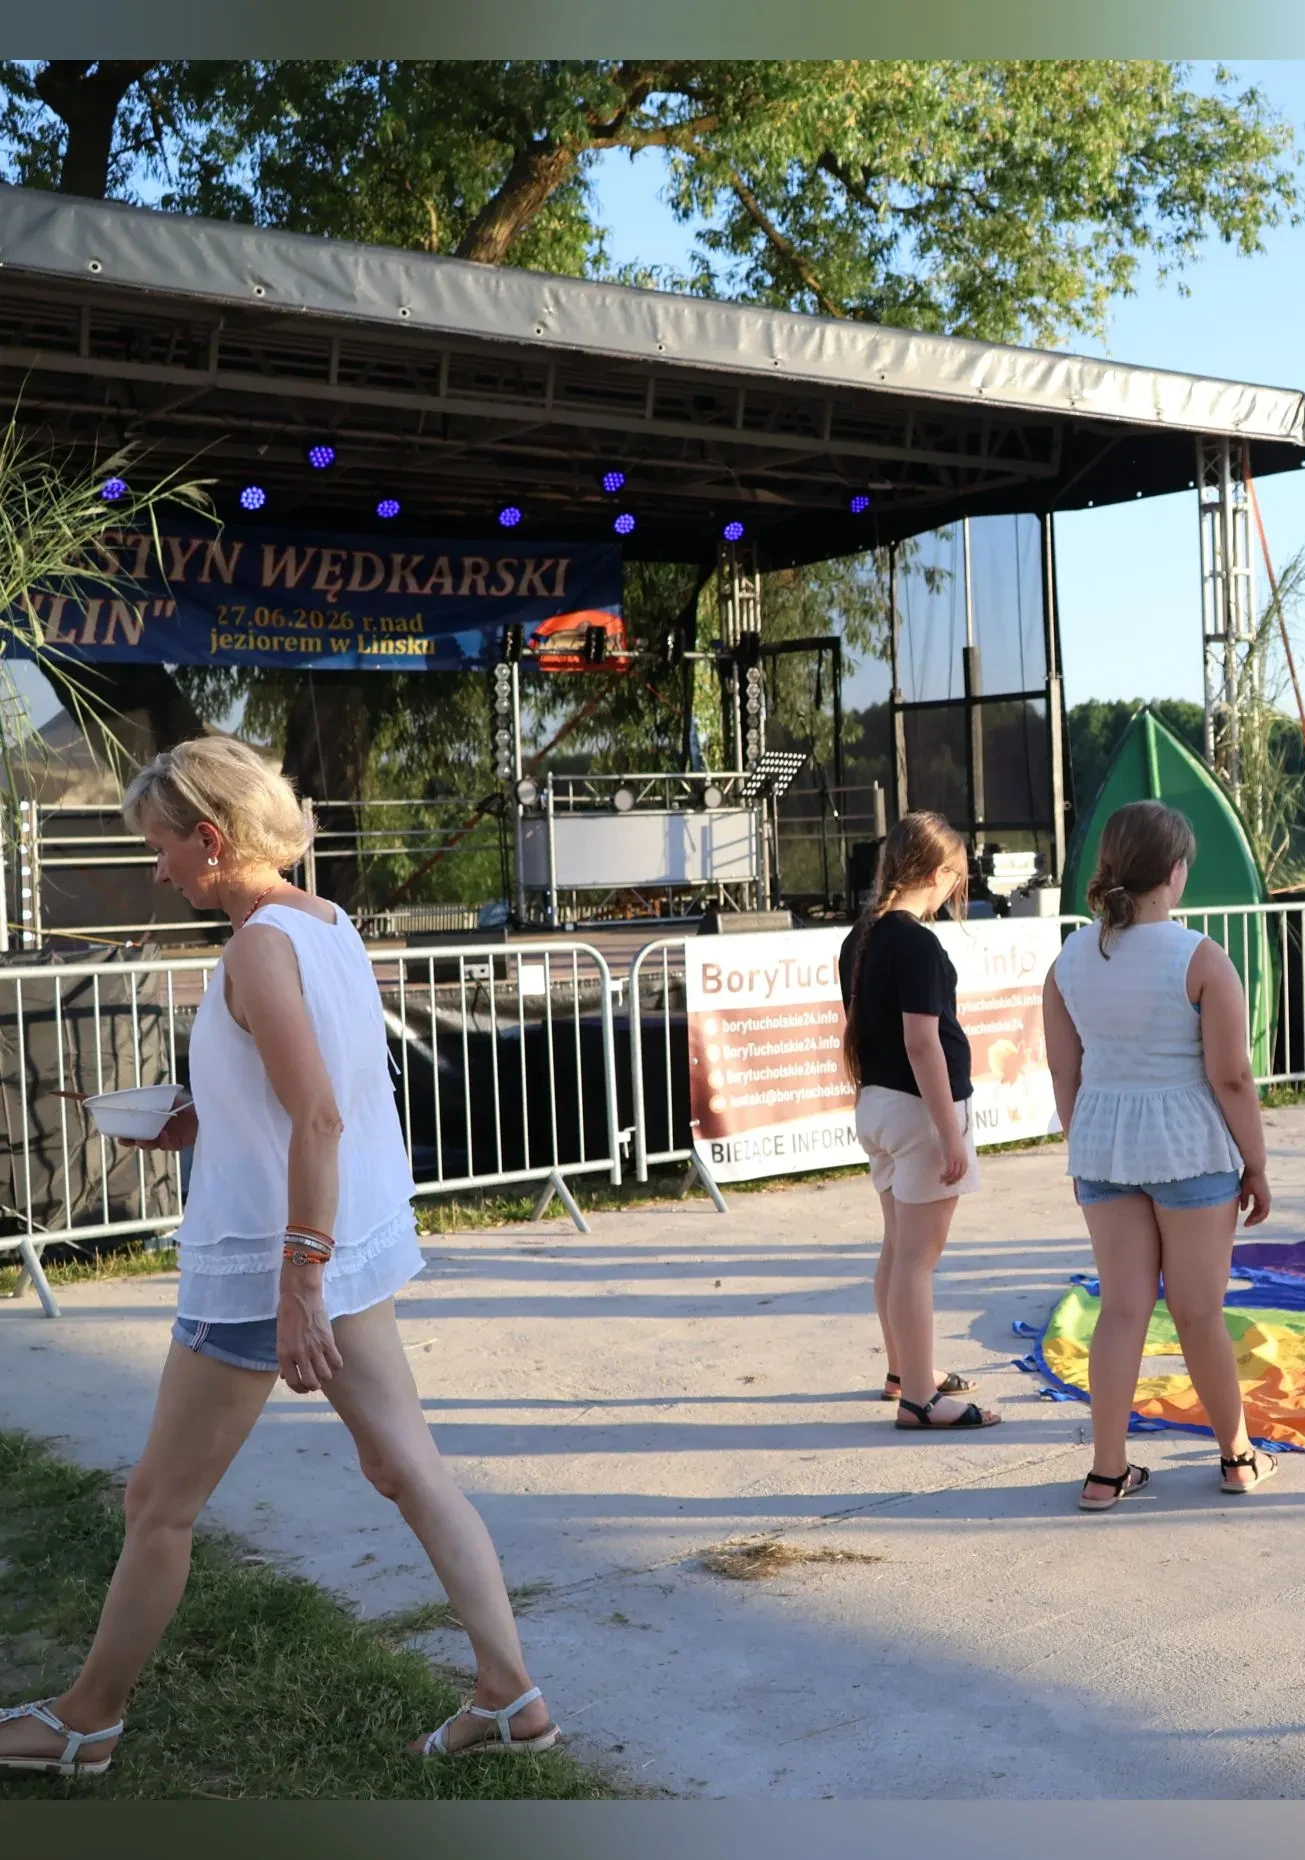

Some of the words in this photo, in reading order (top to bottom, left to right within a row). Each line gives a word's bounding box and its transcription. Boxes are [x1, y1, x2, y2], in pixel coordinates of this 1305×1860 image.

[260, 543, 571, 603] WĘDKARSKI
[216, 604, 354, 631] 27.06.2026
[209, 628, 322, 655] jeziorem
[330, 636, 351, 654] w
[357, 633, 436, 656] Lińsku
[721, 1010, 839, 1035] borytucholskie24.info
[722, 1034, 841, 1061] BoryTucholskie24.info
